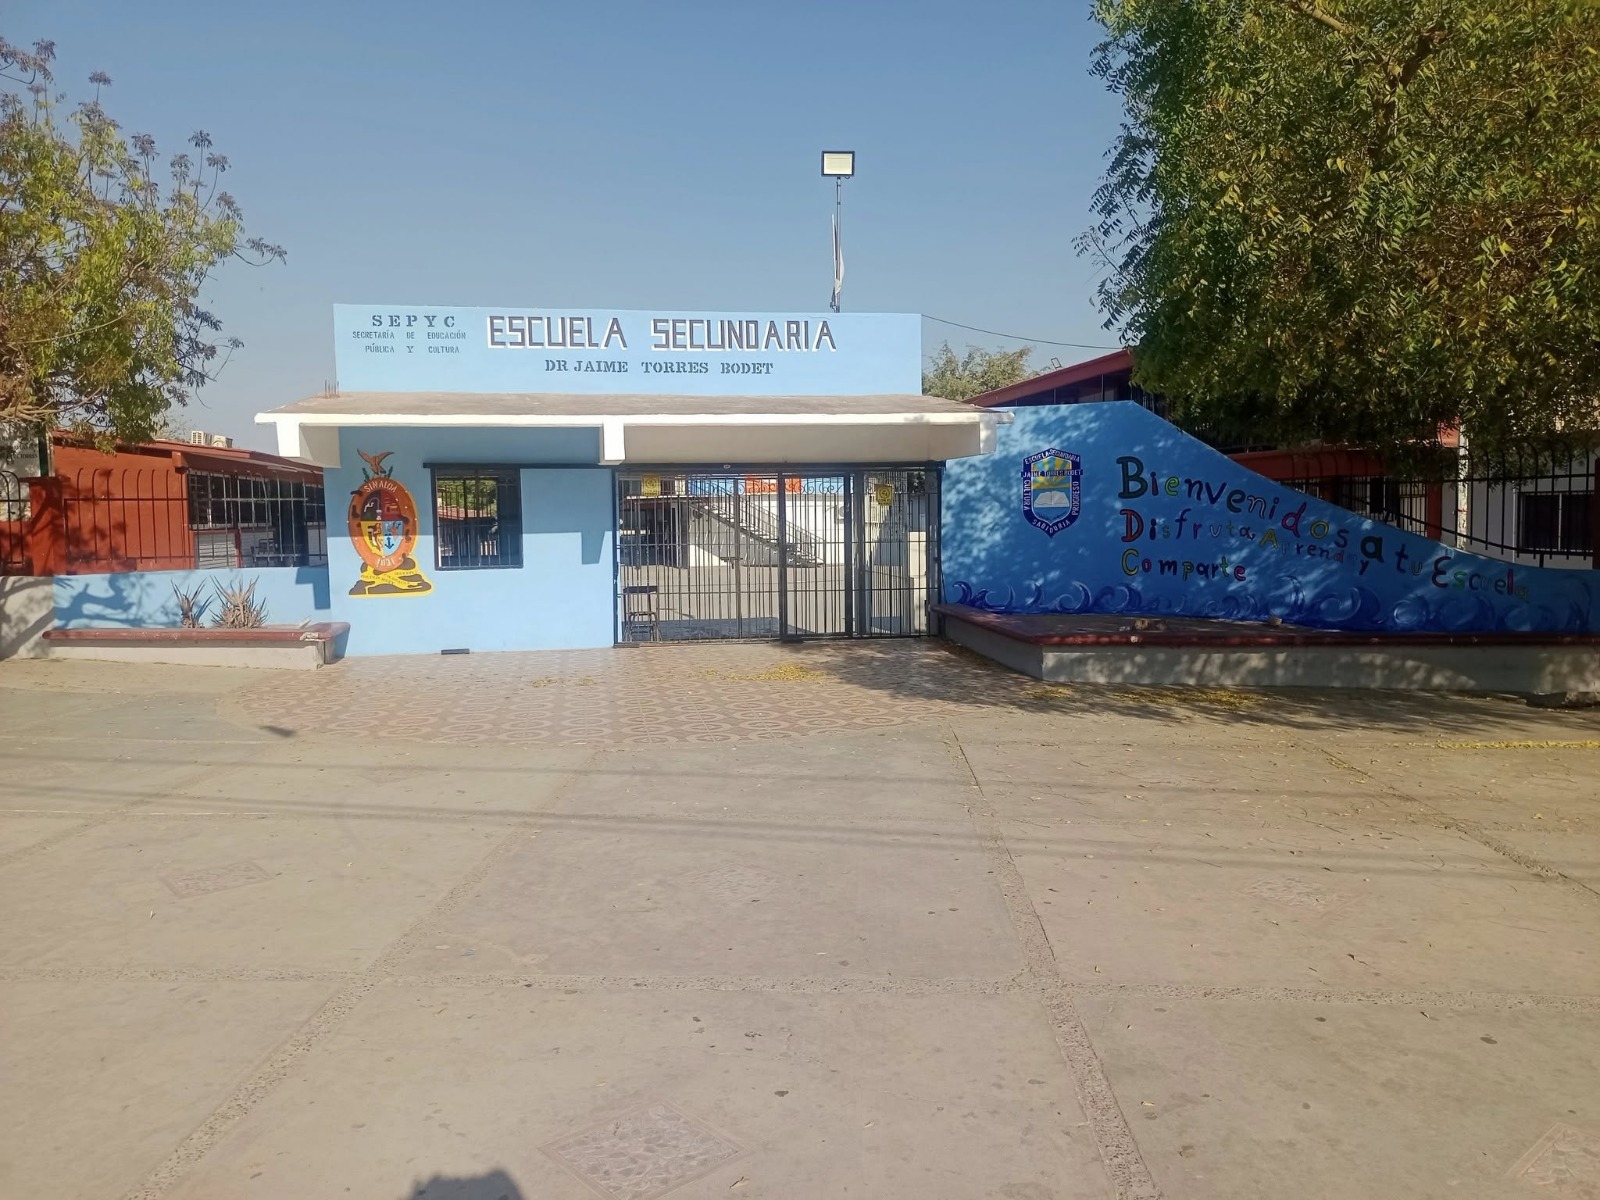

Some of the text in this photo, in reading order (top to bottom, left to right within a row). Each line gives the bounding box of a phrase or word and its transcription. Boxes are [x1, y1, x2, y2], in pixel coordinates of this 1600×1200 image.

[352, 329, 467, 340] SECRETARÍA DE EDUCACIÓN
[486, 315, 837, 351] ESCUELA SECUNDARIA
[365, 342, 460, 354] PÚBLICA Y CULTURA
[545, 359, 774, 375] DR JAIME TORRES BODET
[1024, 450, 1049, 465] ESCUELA
[364, 480, 398, 493] SINALOA
[1023, 479, 1031, 511] CULTURA
[1071, 481, 1080, 516] PROGRESO
[1032, 519, 1071, 534] SABIDURIA
[1115, 456, 1530, 602] Bienvenidos a tu Escuela
